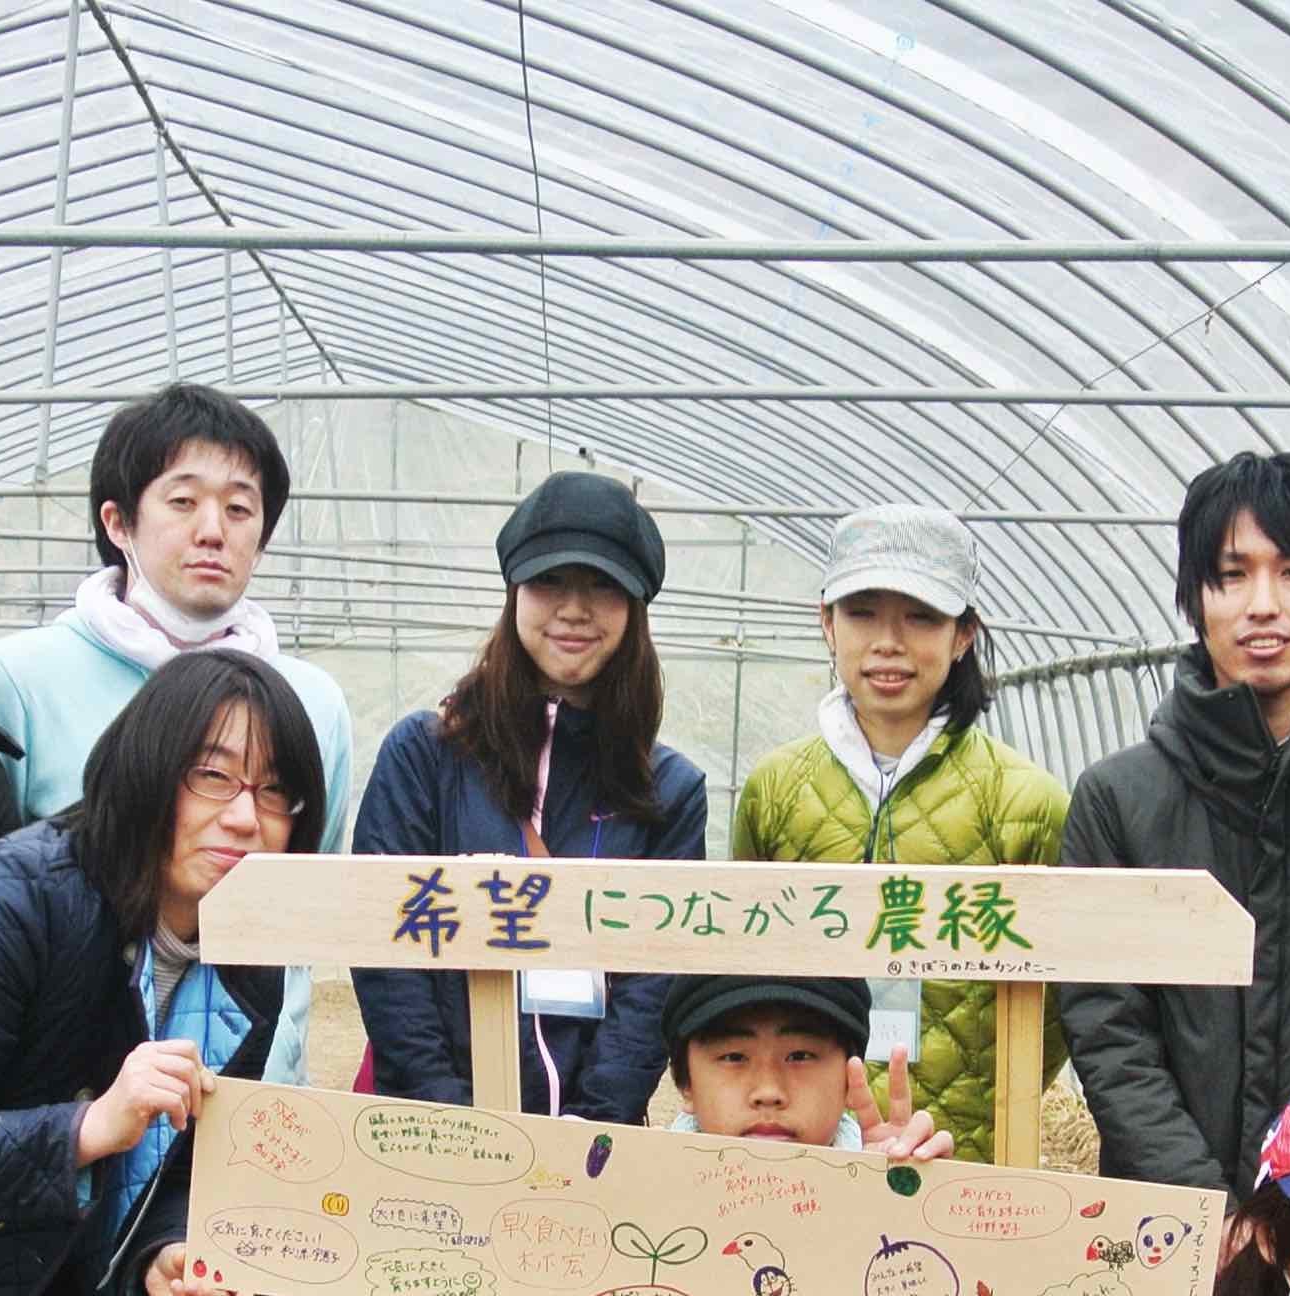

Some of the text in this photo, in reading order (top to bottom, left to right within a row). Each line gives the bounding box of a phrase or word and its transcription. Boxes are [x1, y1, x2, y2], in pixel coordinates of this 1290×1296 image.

[391, 866, 1035, 958] 希望につながる農縁
